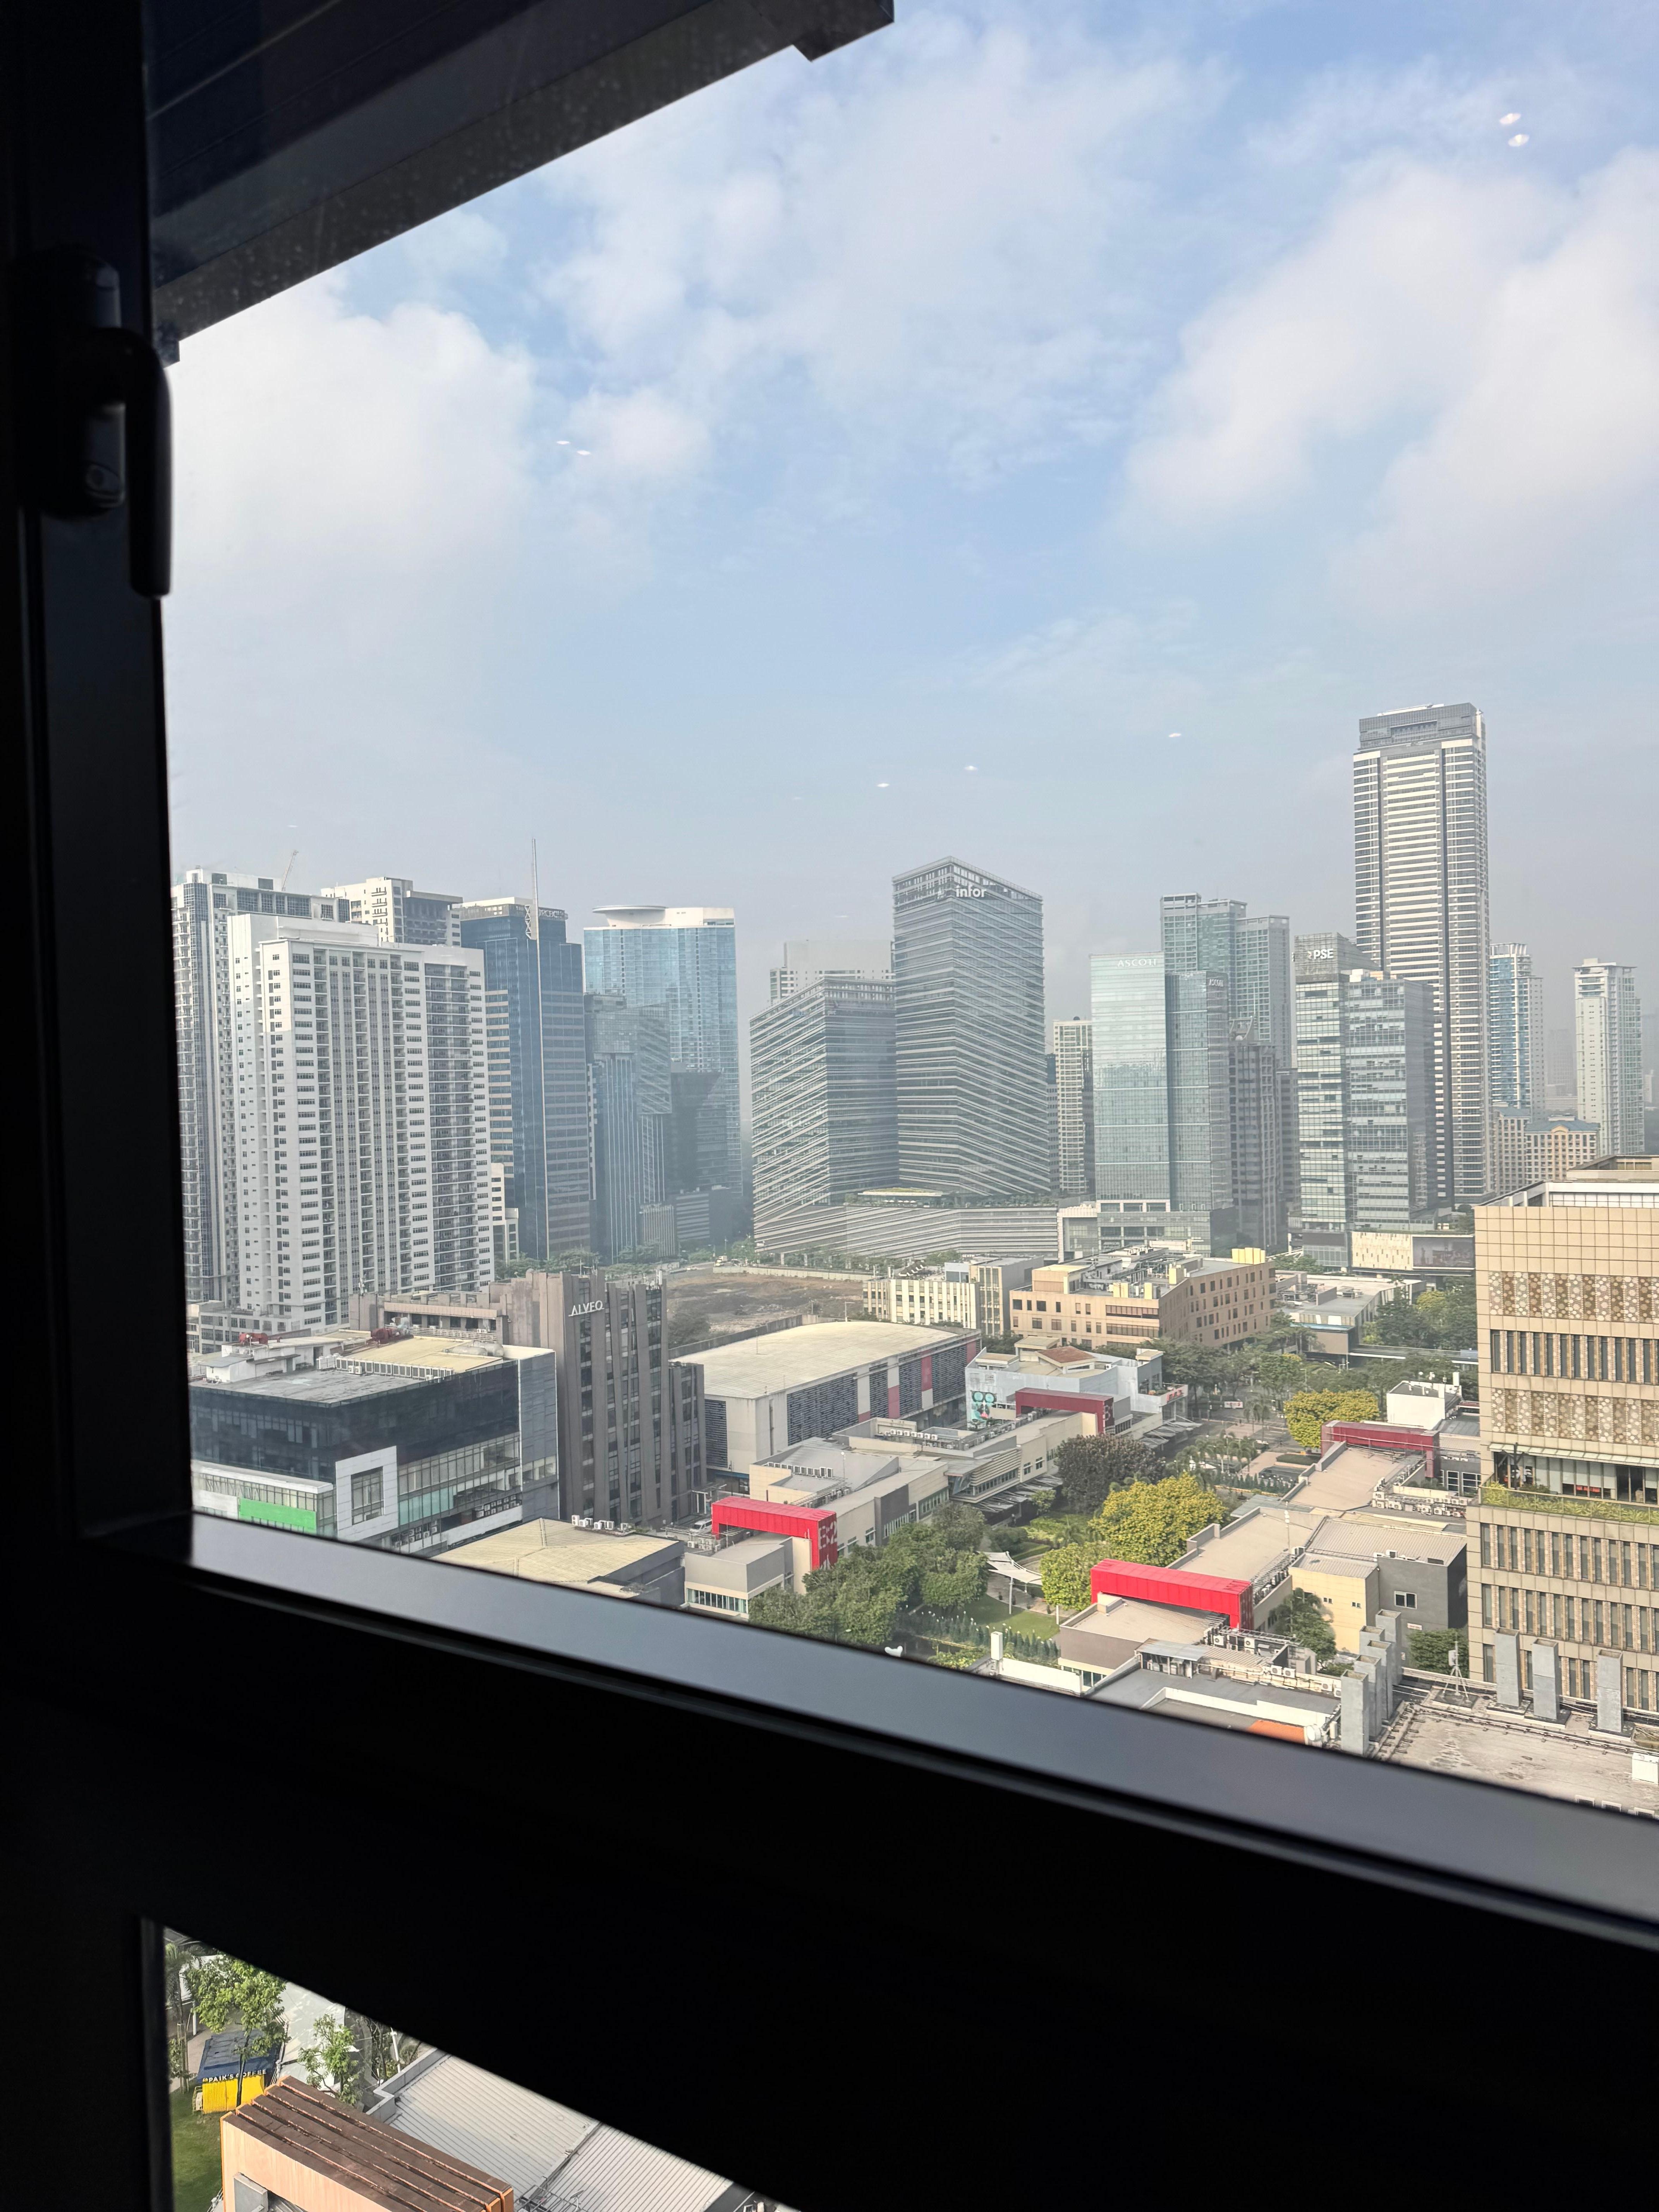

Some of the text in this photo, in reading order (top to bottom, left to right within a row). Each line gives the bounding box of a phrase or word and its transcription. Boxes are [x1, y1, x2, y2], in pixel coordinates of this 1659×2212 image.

[956, 884, 987, 897] infor
[1313, 948, 1334, 960] PSE
[1117, 958, 1158, 967] ASCOTT
[568, 1300, 604, 1317] ALVEO
[208, 2073, 234, 2083] PAIK'S
